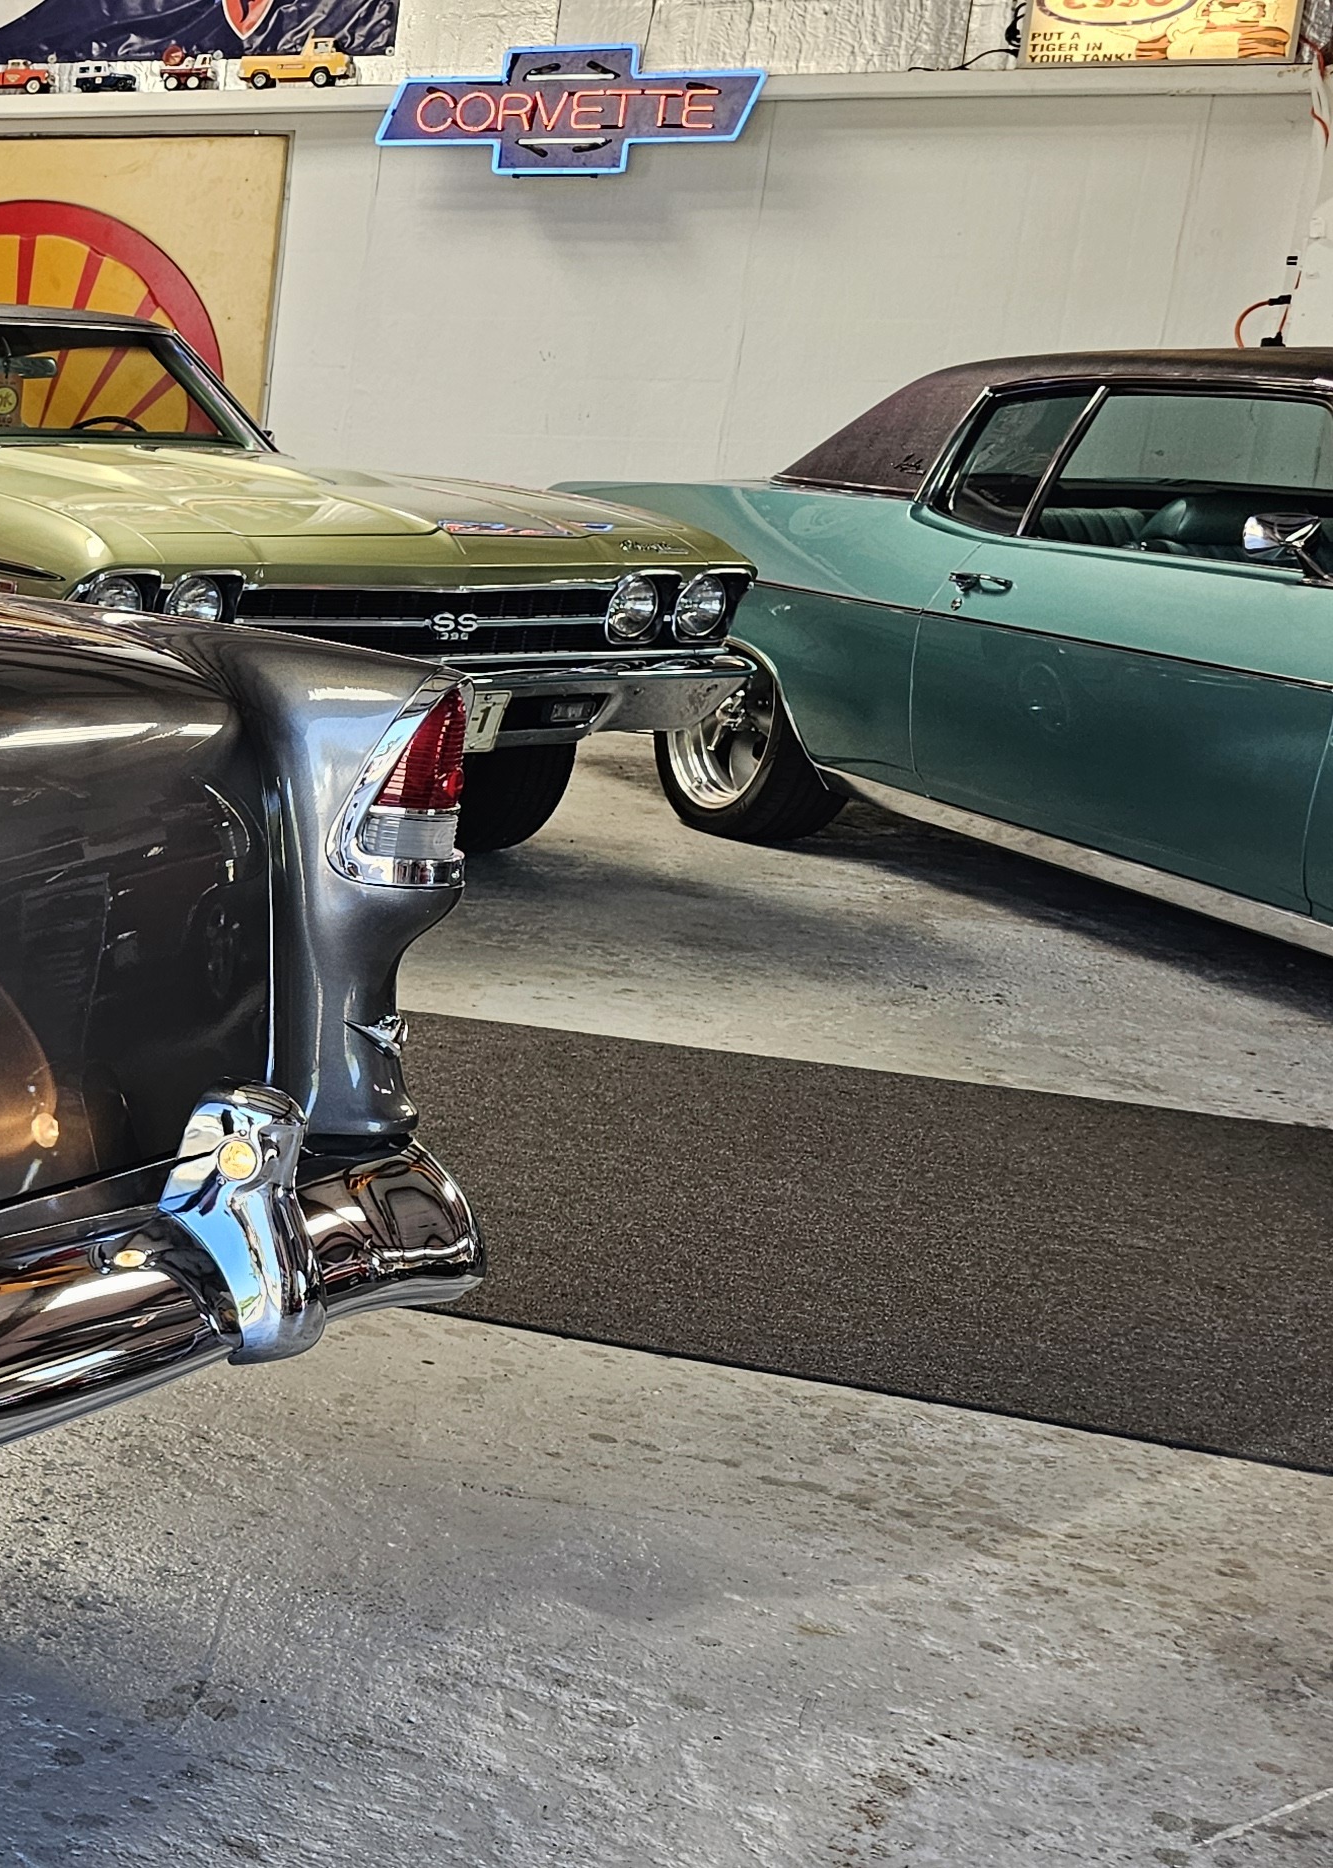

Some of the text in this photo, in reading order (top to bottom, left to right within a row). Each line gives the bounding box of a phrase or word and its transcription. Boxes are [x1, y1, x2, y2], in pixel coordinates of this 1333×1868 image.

[1031, 32, 1081, 41] PUT A
[1030, 42, 1103, 52] TIGER IN
[1028, 53, 1132, 63] YOUR TANK!
[416, 90, 719, 131] CORVETTE
[433, 613, 478, 632] SS
